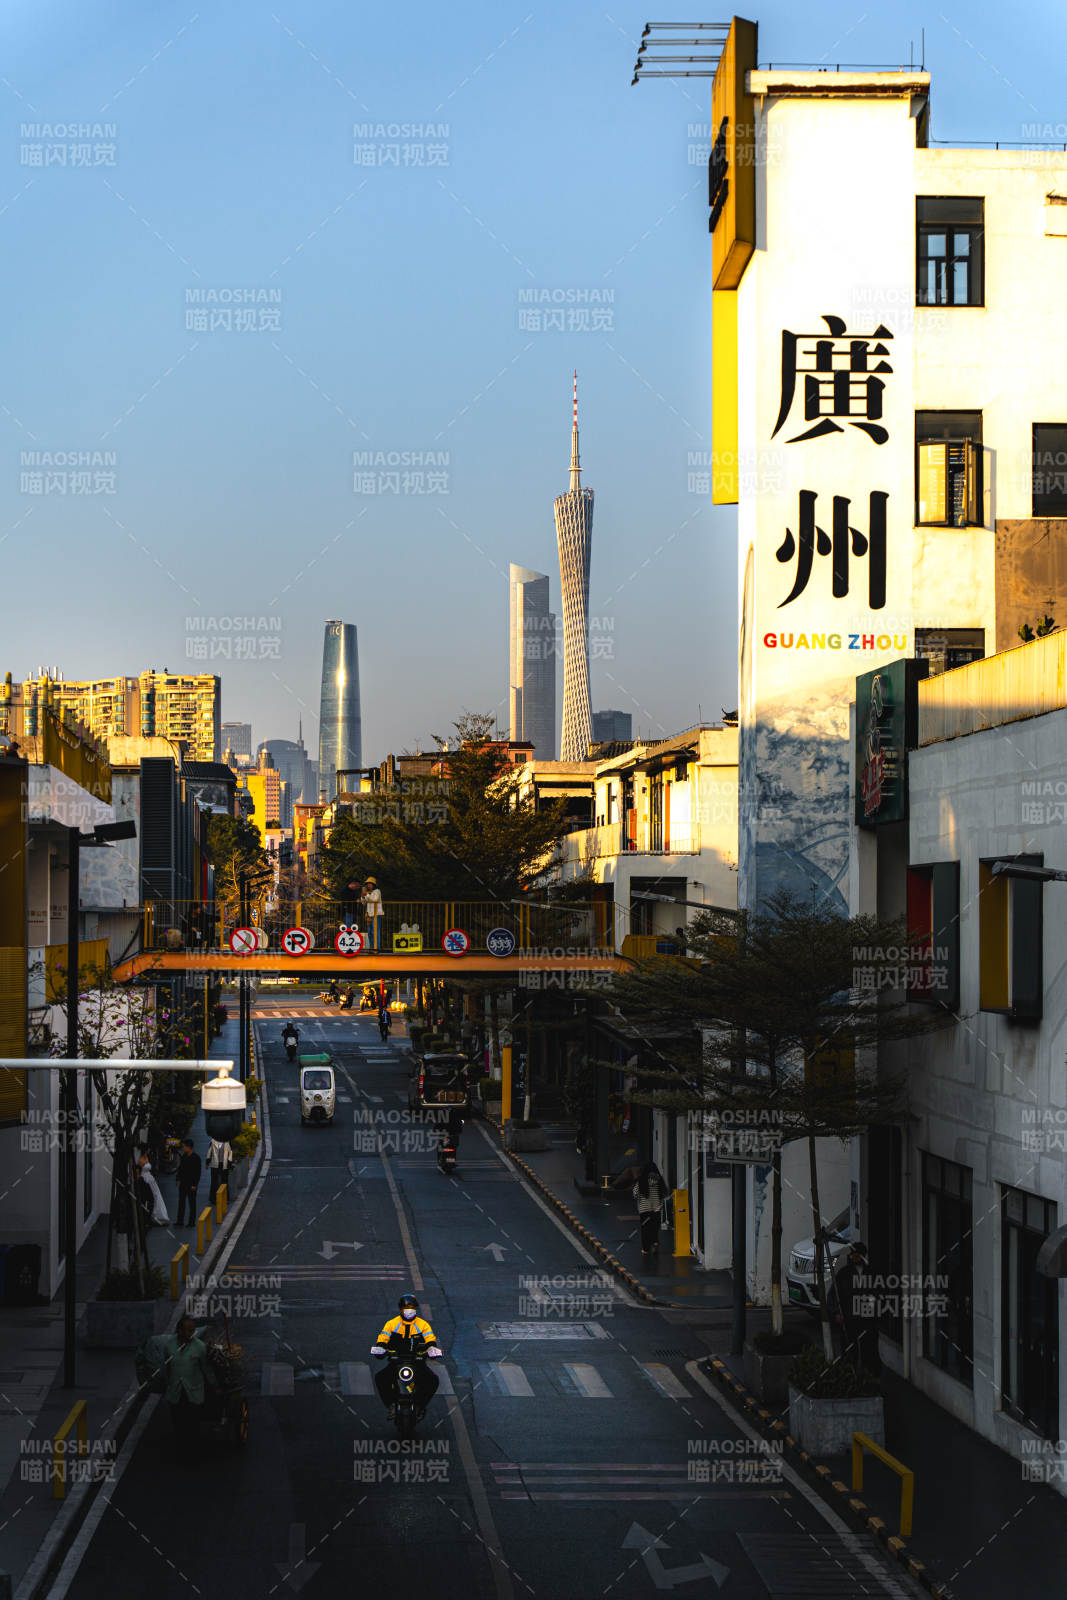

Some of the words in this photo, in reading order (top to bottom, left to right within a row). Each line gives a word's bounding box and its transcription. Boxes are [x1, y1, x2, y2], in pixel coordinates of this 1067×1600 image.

[771, 315, 894, 610] 廣州
[763, 633, 842, 650] GUANG
[847, 633, 907, 651] ZHOU
[340, 937, 361, 948] 4.2m
